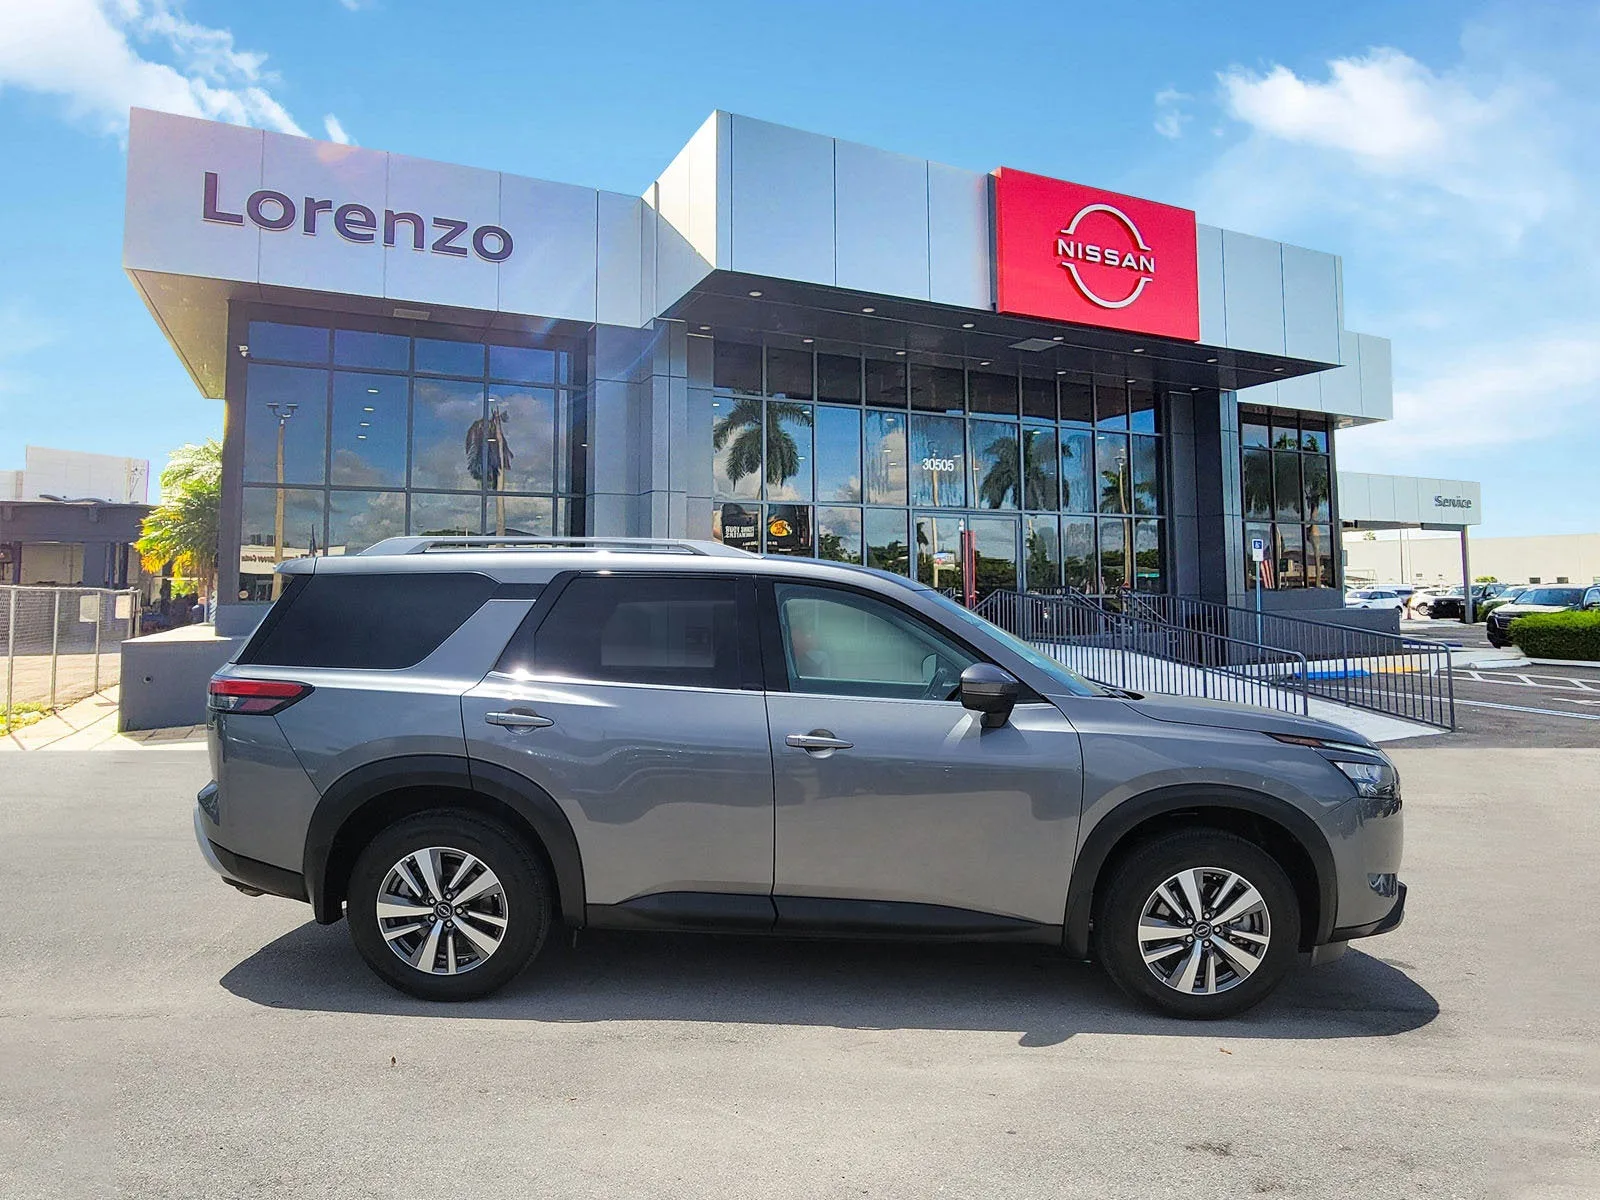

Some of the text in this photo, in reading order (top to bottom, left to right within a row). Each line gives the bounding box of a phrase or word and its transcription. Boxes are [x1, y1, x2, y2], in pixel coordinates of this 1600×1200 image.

[202, 171, 514, 263] Lorenzo
[1056, 238, 1156, 273] NISSAN
[922, 457, 954, 472] 30505
[1434, 495, 1472, 509] Service
